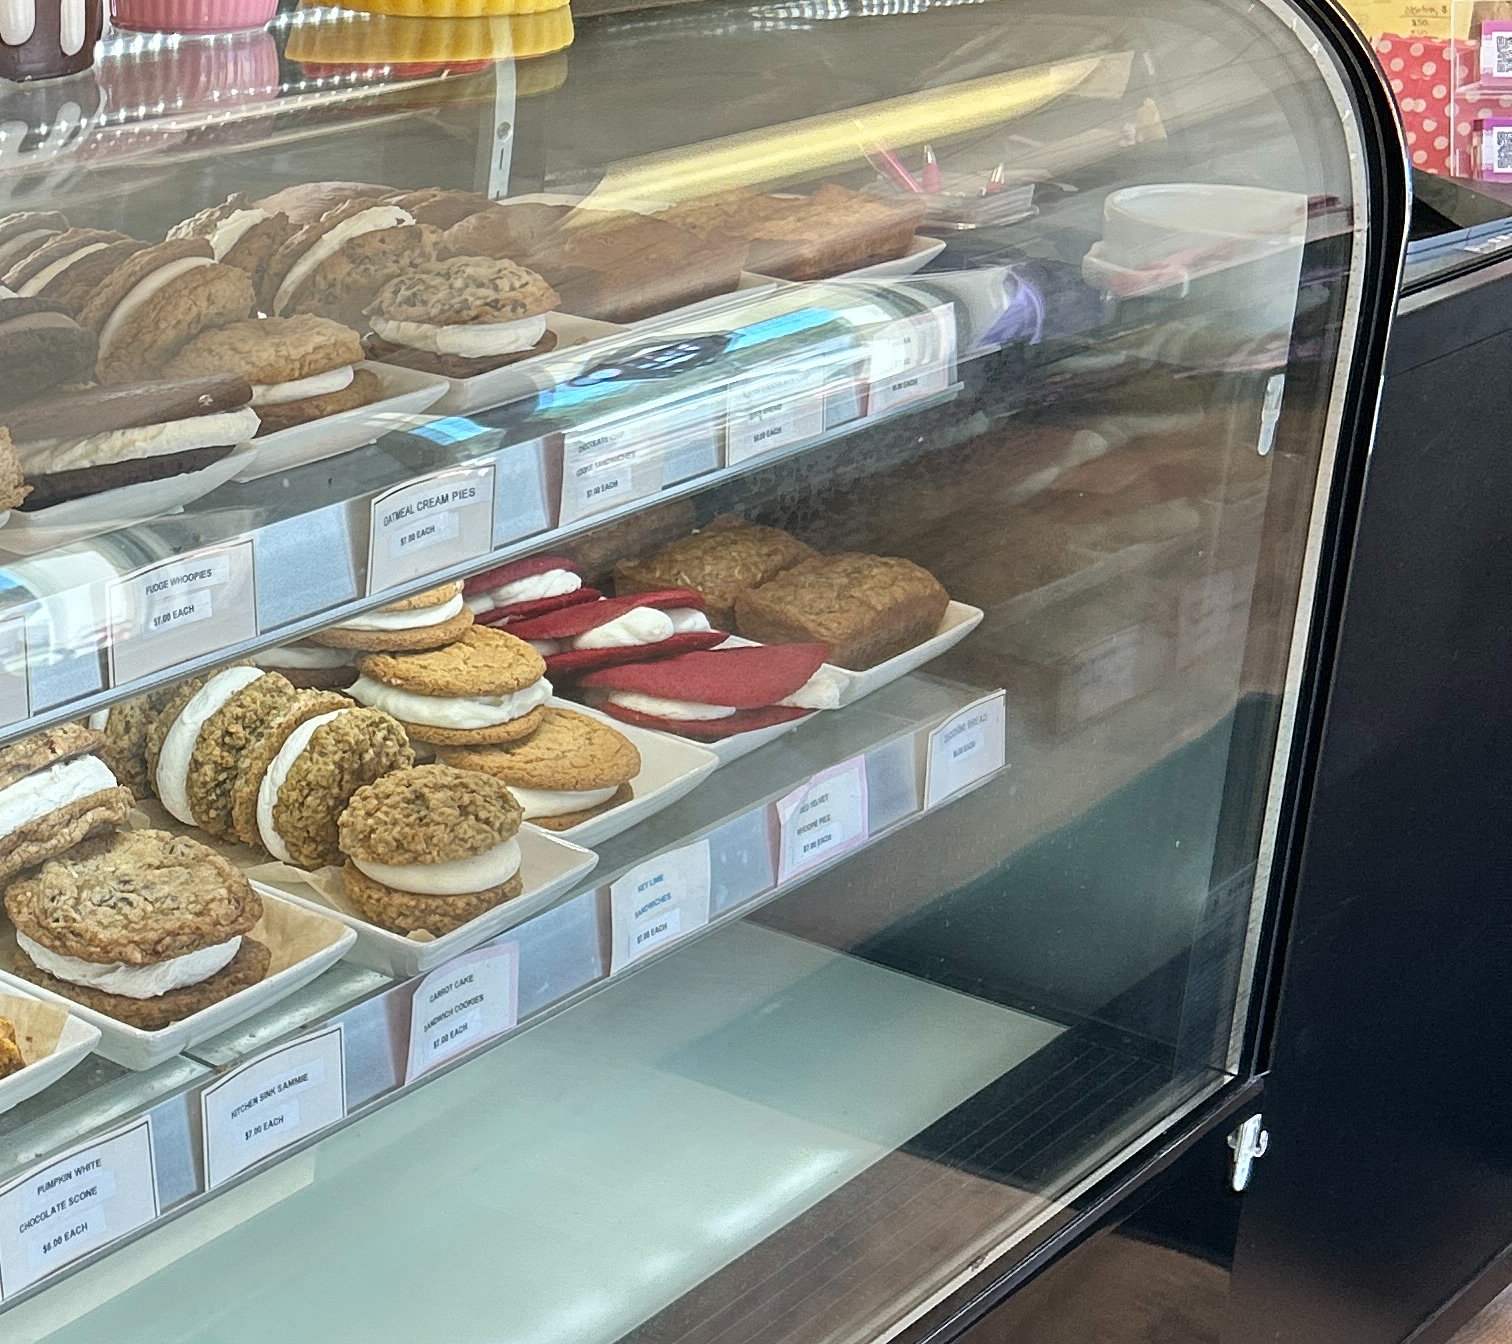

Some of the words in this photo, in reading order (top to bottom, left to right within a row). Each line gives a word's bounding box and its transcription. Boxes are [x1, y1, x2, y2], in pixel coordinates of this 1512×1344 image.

[383, 504, 415, 527] OATMEAL
[416, 494, 449, 512] CREAM
[452, 487, 476, 501] PIES
[416, 525, 435, 539] EACH
[145, 579, 169, 595] FUDGE
[170, 568, 212, 586] WHOOPIES
[172, 604, 195, 619] EACH
[650, 922, 668, 936] EACH
[429, 983, 453, 1003] CARROT
[454, 974, 474, 989] CAKE
[424, 1008, 454, 1032] SANDWICH
[454, 993, 484, 1013] COOKIES
[449, 1022, 468, 1039] EACH
[231, 1096, 259, 1119] KITCHEN
[259, 1087, 276, 1102] SINK
[277, 1073, 308, 1093] SAMMIE
[245, 1125, 262, 1140] $7.00
[263, 1115, 284, 1131] EACH
[37, 1171, 72, 1196] PUMPKIN
[73, 1158, 102, 1177] WHITE
[19, 1199, 67, 1234] CHOCOLATE
[68, 1185, 98, 1207] SCONE
[42, 1235, 63, 1254] $6.00
[64, 1222, 88, 1242] EACH
